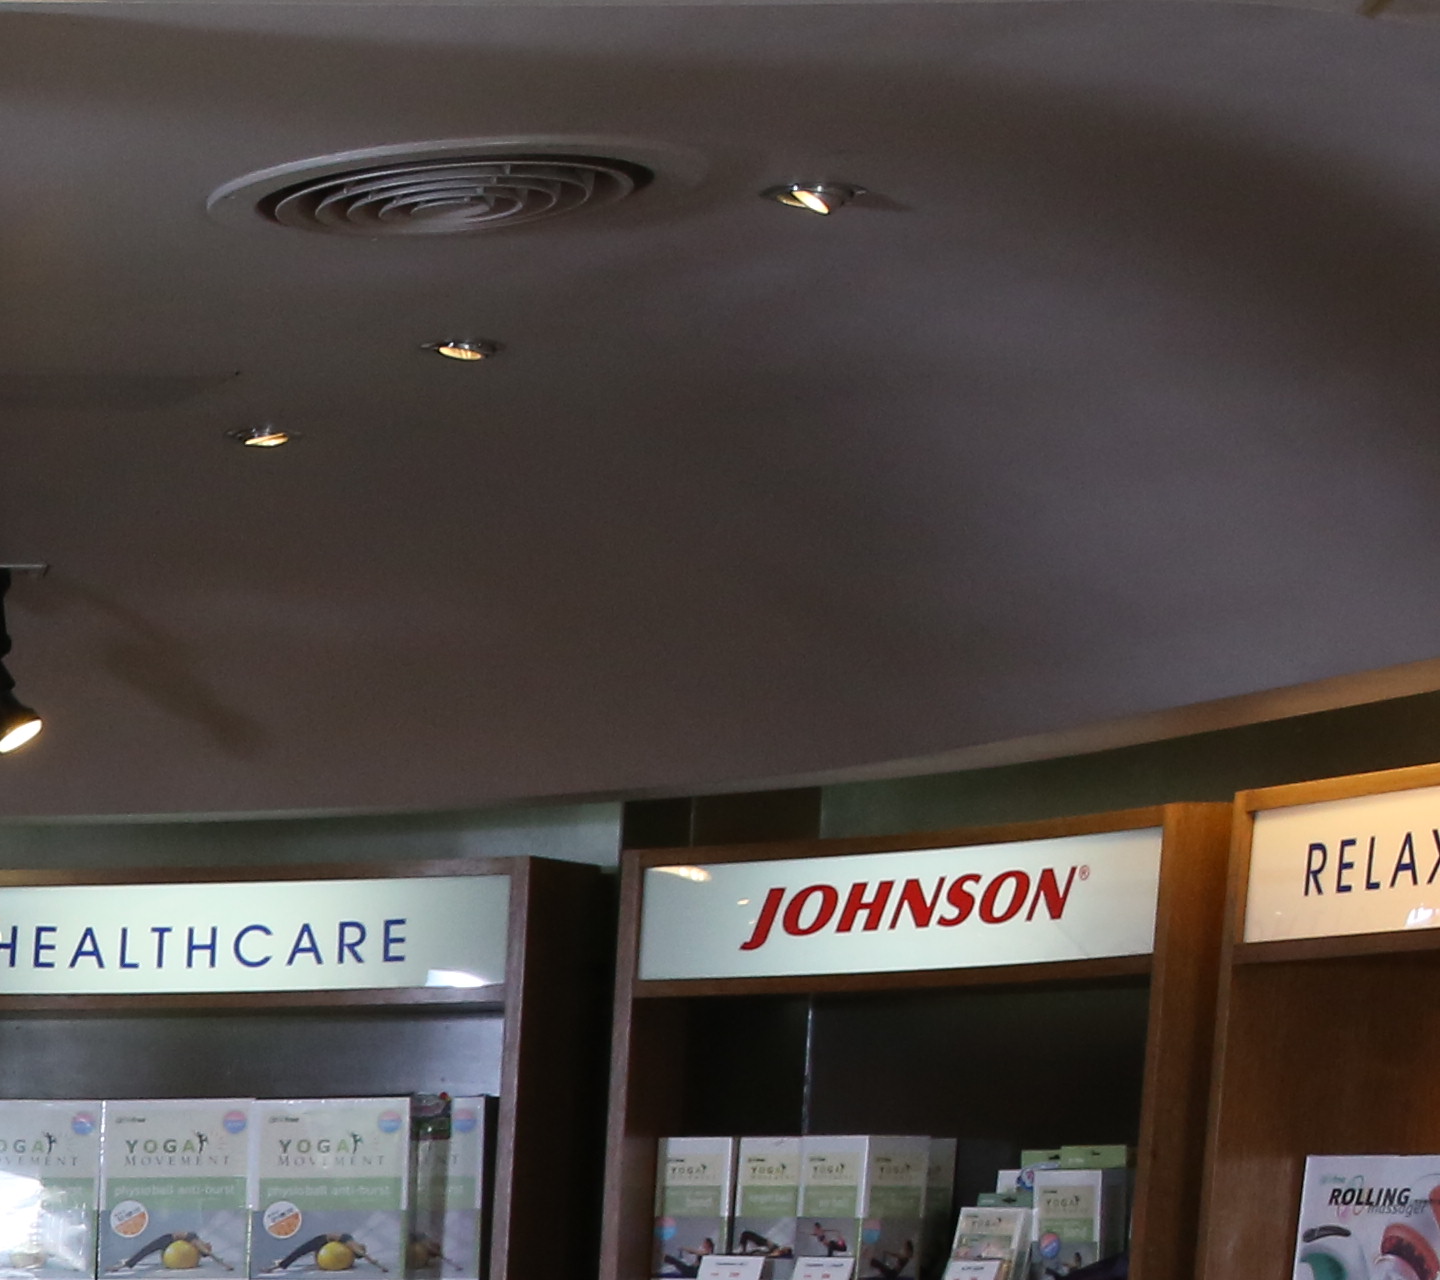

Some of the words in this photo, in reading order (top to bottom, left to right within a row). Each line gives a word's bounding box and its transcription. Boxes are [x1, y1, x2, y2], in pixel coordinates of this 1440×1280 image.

[740, 866, 1078, 950] JOHNSON
[125, 1139, 195, 1154] YOGA
[278, 1139, 350, 1154] YOGA
[1328, 1187, 1411, 1206] ROLLING
